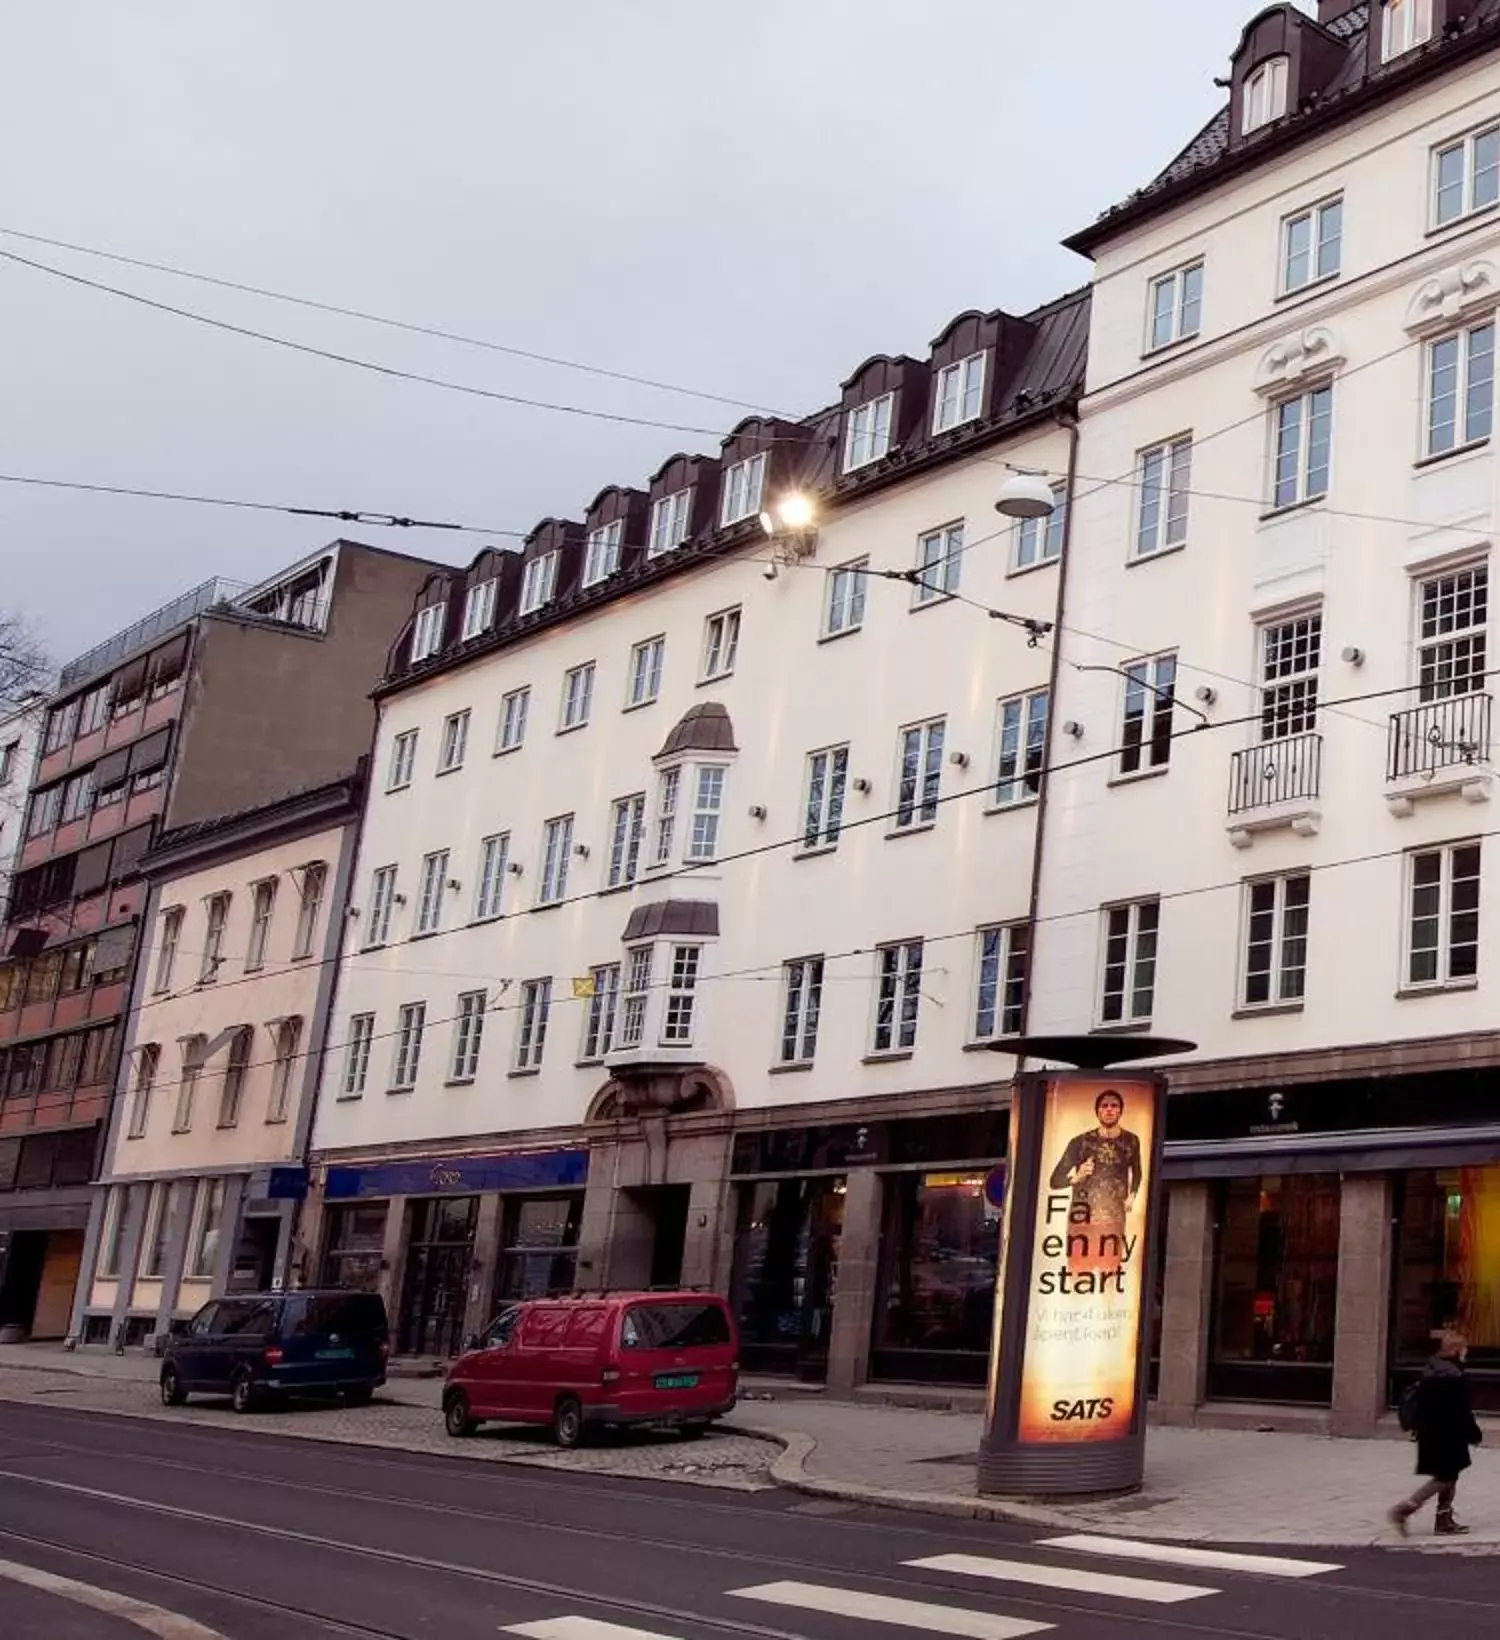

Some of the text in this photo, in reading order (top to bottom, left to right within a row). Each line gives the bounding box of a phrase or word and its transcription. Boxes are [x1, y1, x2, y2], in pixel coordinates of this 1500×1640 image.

[1046, 1188, 1091, 1224] Få
[1042, 1234, 1137, 1263] en ny
[1038, 1265, 1126, 1295] start
[1049, 1397, 1114, 1421] SATS
